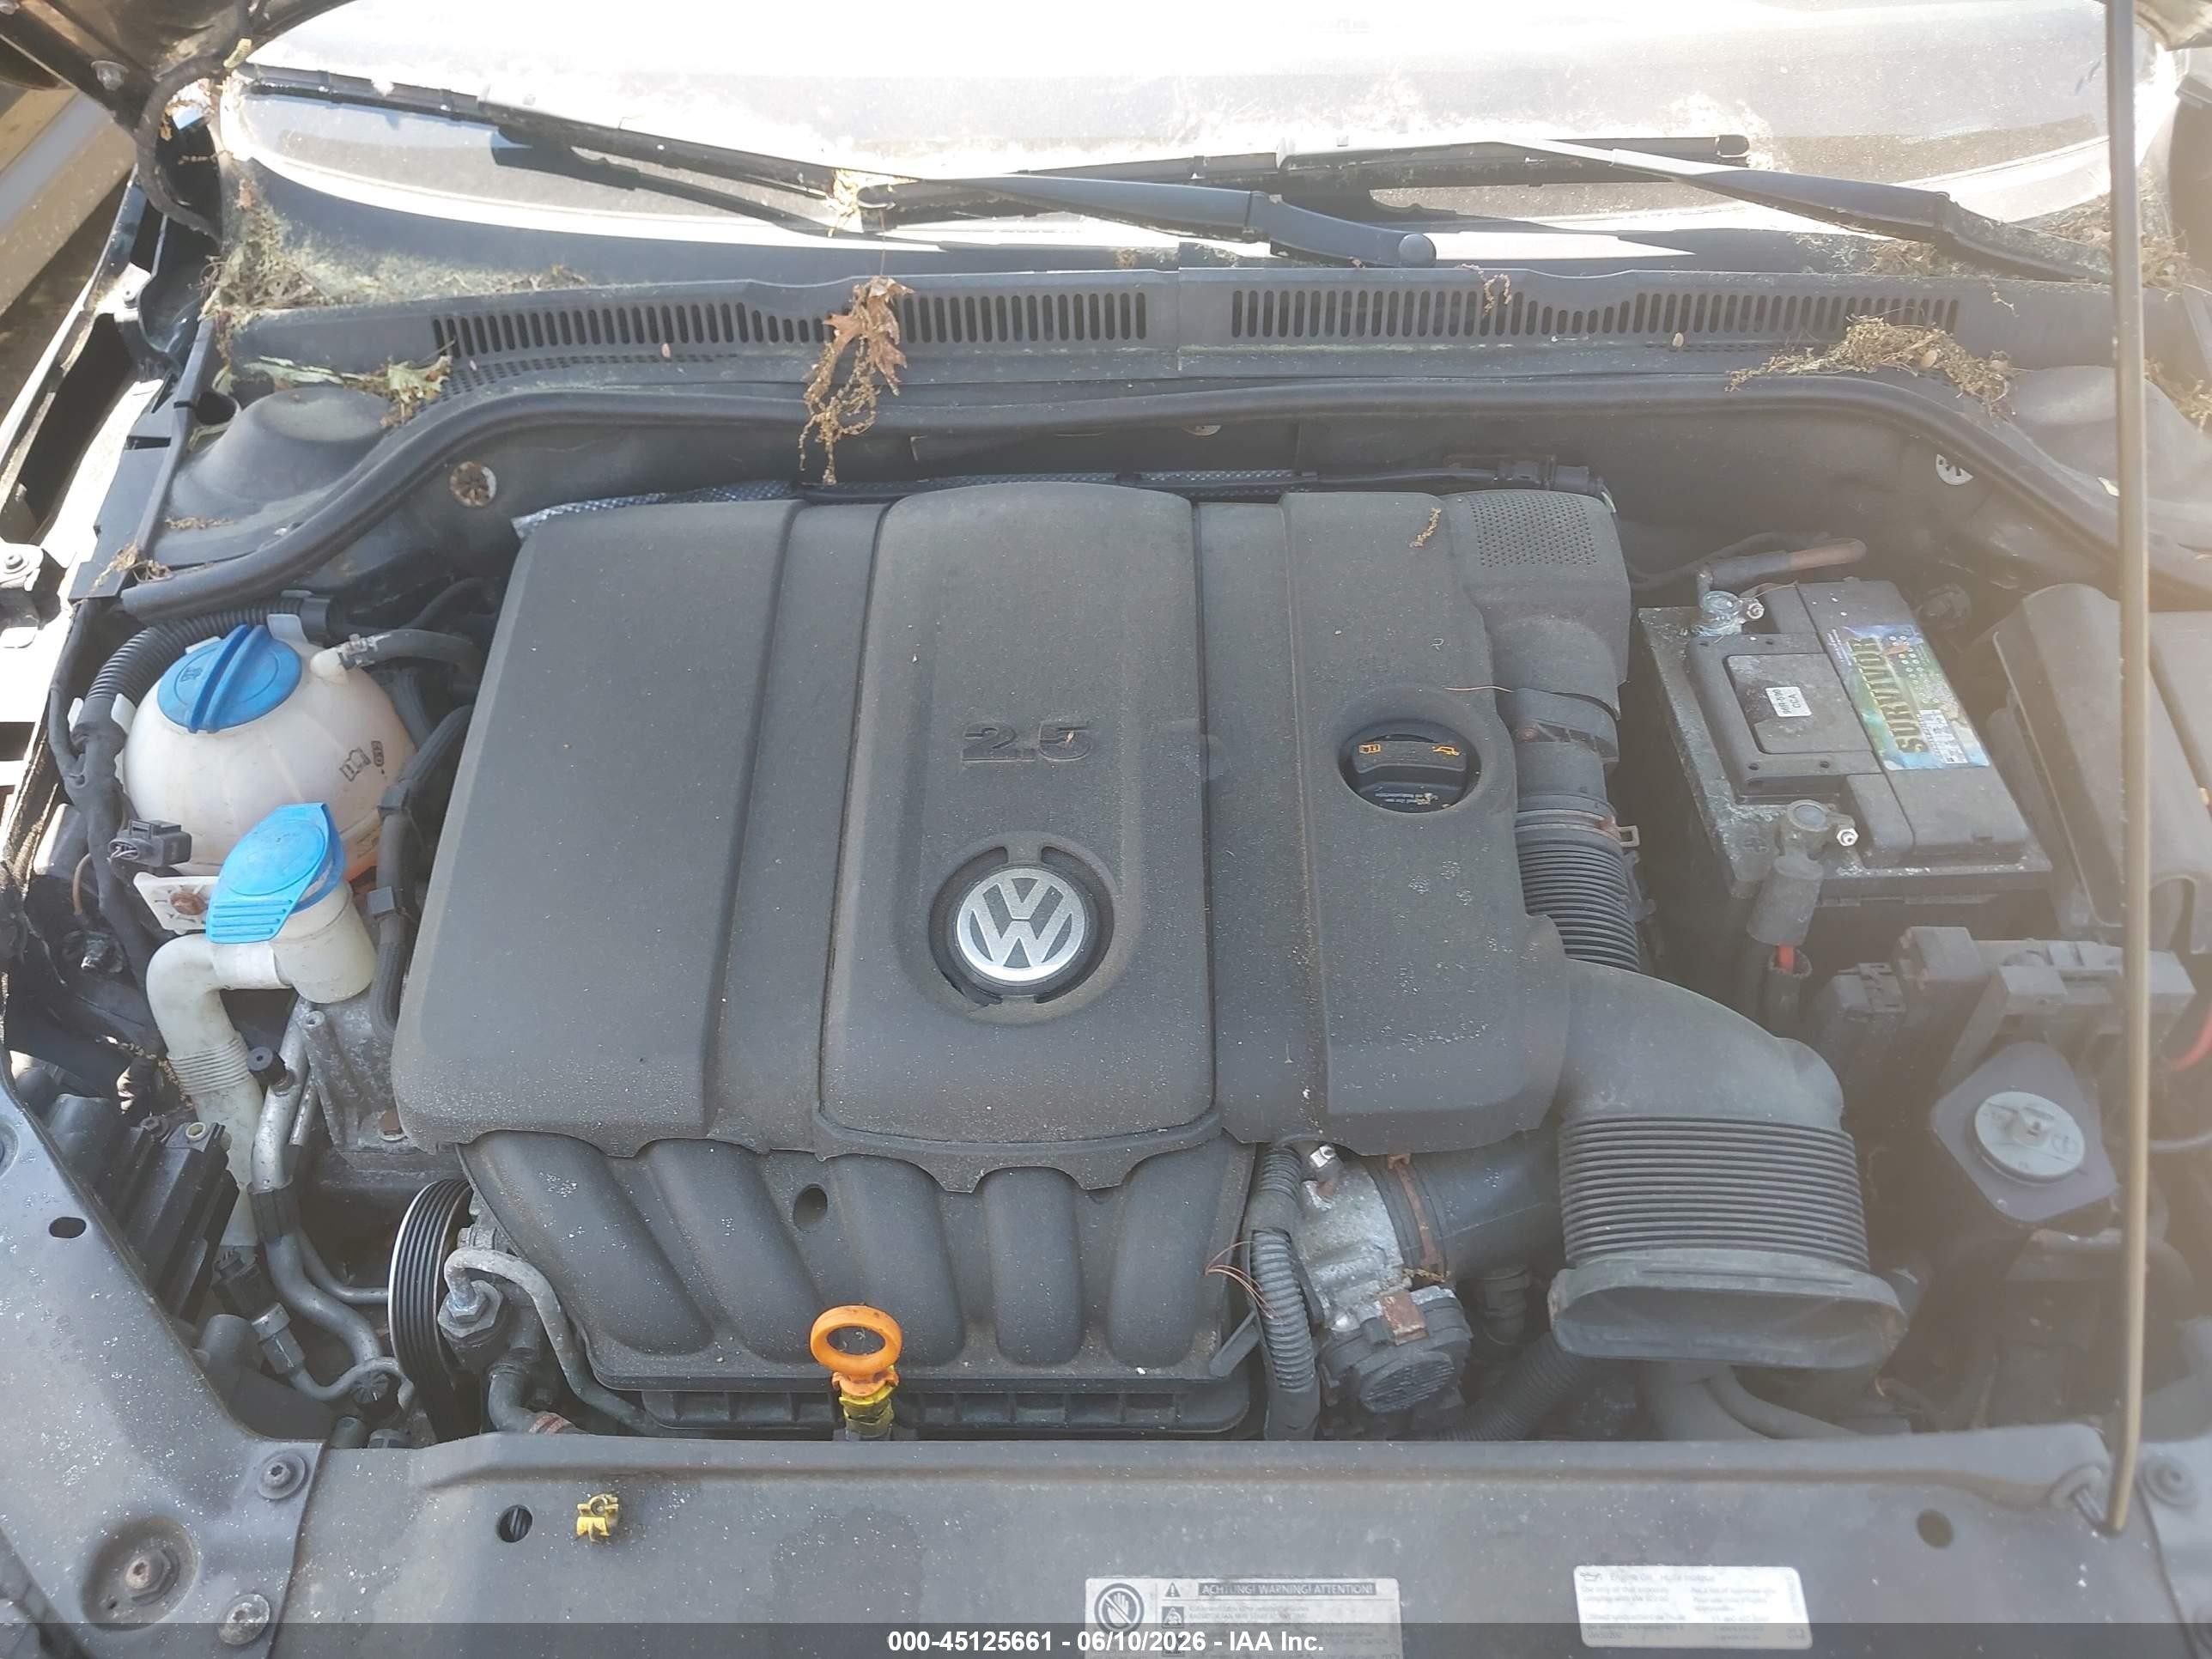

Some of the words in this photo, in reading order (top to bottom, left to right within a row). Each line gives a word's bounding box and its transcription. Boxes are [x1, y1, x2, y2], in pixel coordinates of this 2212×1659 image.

[1788, 694, 1801, 708] CCA
[1848, 638, 1929, 753] SURVIVOR
[961, 720, 1093, 762] 2.5
[1201, 1584, 1254, 1595] ACHTUNG!
[1258, 1584, 1312, 1595] WARNING!
[1314, 1584, 1374, 1595] ATTENTION!
